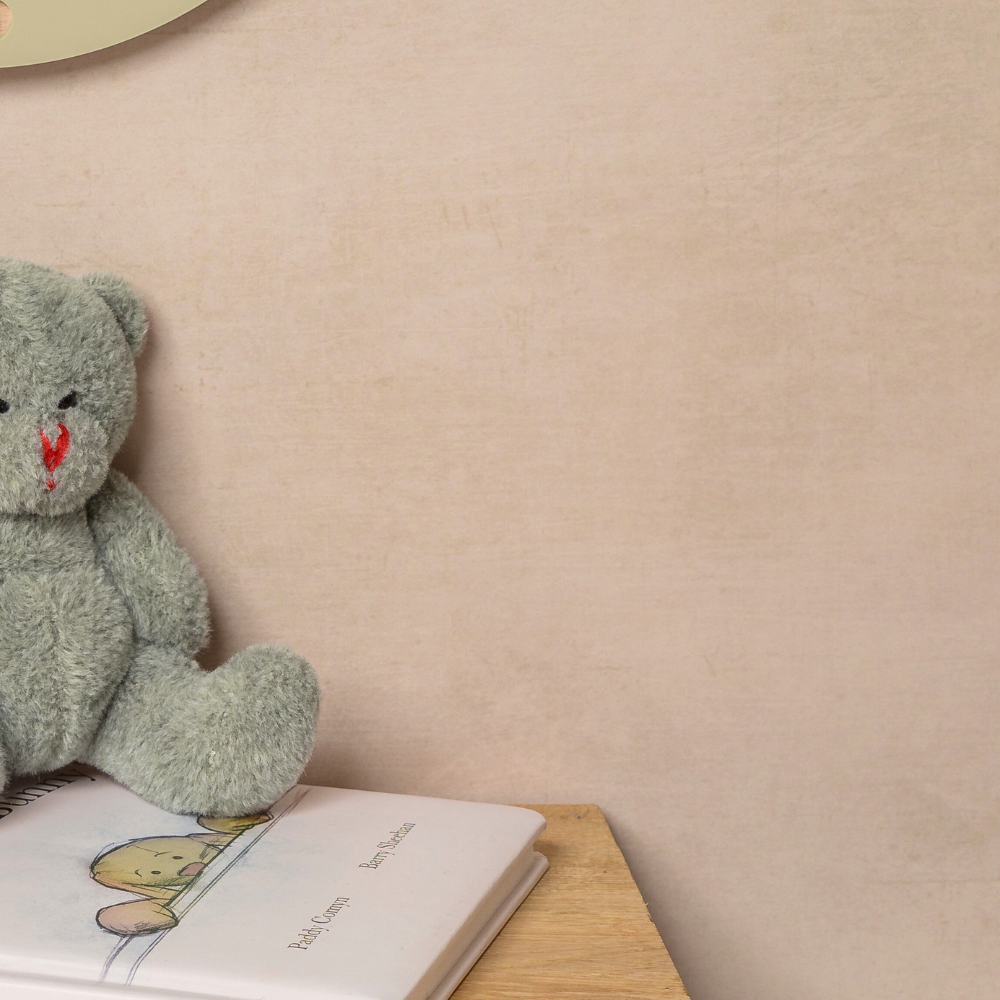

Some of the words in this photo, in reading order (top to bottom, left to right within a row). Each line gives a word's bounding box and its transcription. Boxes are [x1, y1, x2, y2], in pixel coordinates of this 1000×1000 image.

[376, 822, 416, 850] Sheehan
[358, 849, 395, 869] Barry
[287, 924, 330, 950] Paddy
[310, 896, 350, 924] Comyn
